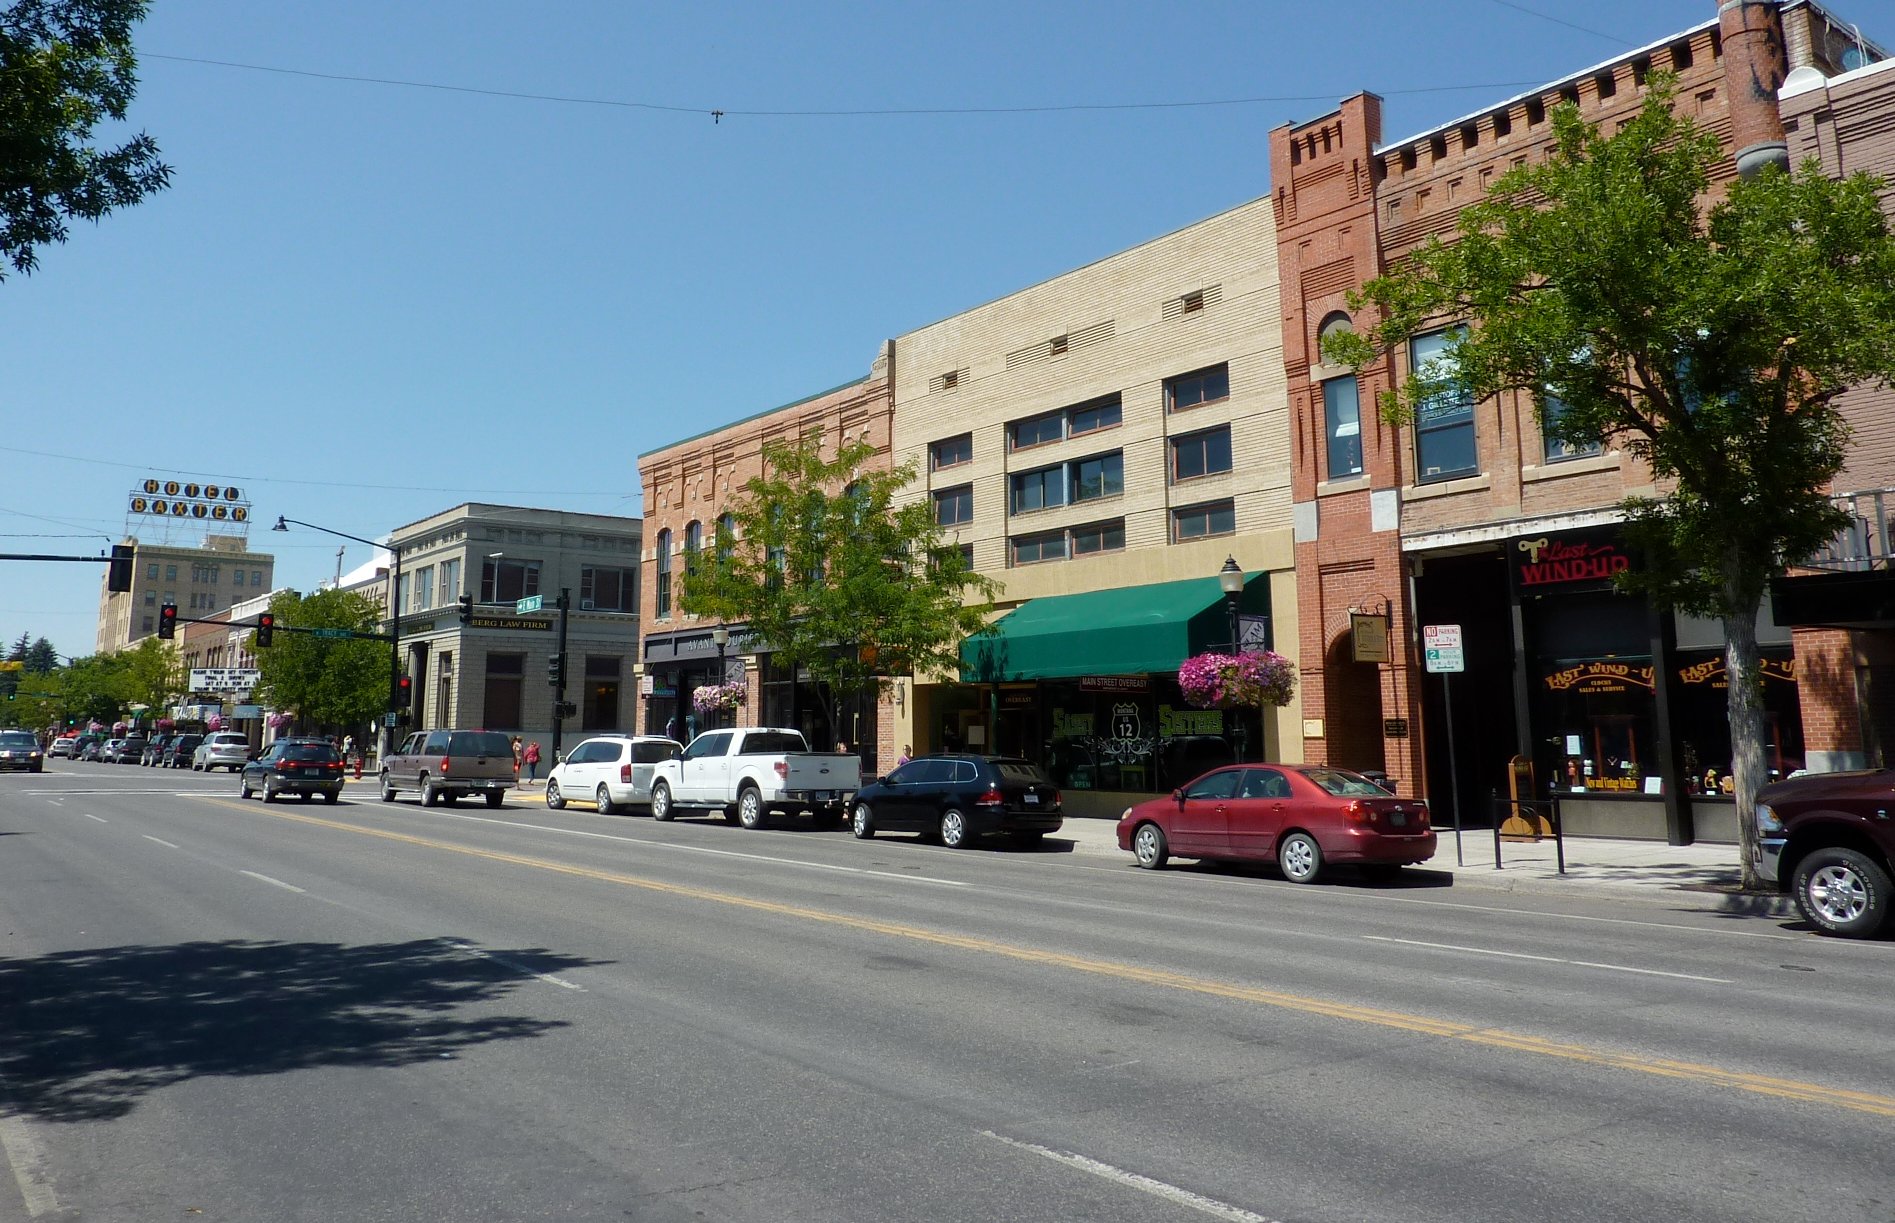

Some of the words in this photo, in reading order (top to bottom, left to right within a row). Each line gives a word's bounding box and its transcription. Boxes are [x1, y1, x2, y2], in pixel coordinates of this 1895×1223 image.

[146, 480, 237, 500] HOTEL
[134, 498, 245, 520] BAXTER
[1548, 540, 1603, 561] Last
[1426, 628, 1436, 636] NO
[1430, 650, 1436, 658] 2
[1545, 664, 1584, 689] LAST
[1679, 657, 1720, 683] LAST
[1082, 677, 1096, 686] MAIN
[1097, 678, 1118, 687] STREET
[1119, 678, 1147, 688] OVEREASY
[1119, 724, 1133, 737] 12
